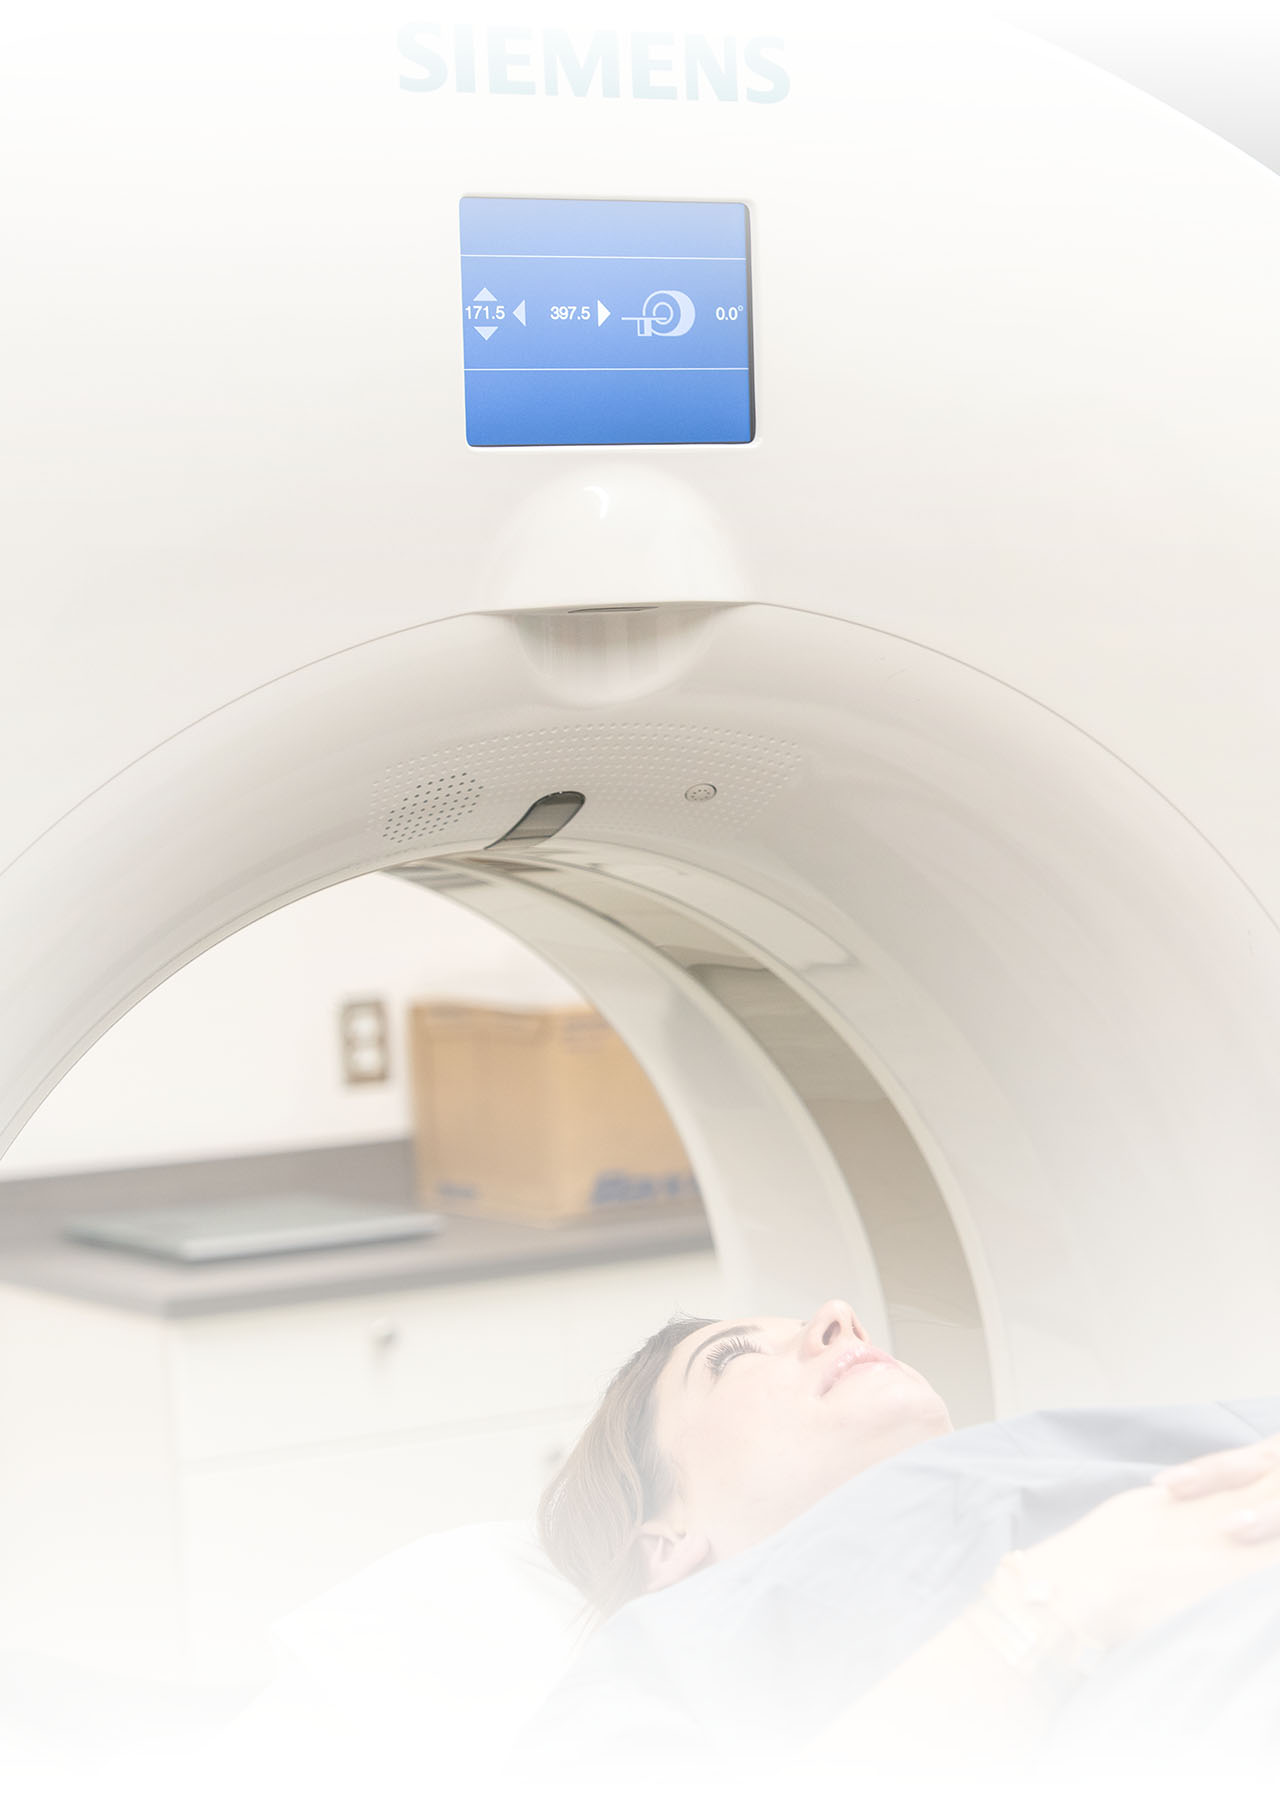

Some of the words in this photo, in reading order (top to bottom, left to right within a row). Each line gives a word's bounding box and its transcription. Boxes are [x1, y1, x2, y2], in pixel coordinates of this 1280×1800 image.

[396, 22, 791, 104] SIEMENS
[465, 306, 505, 320] 171.5
[550, 306, 591, 321] 397.5
